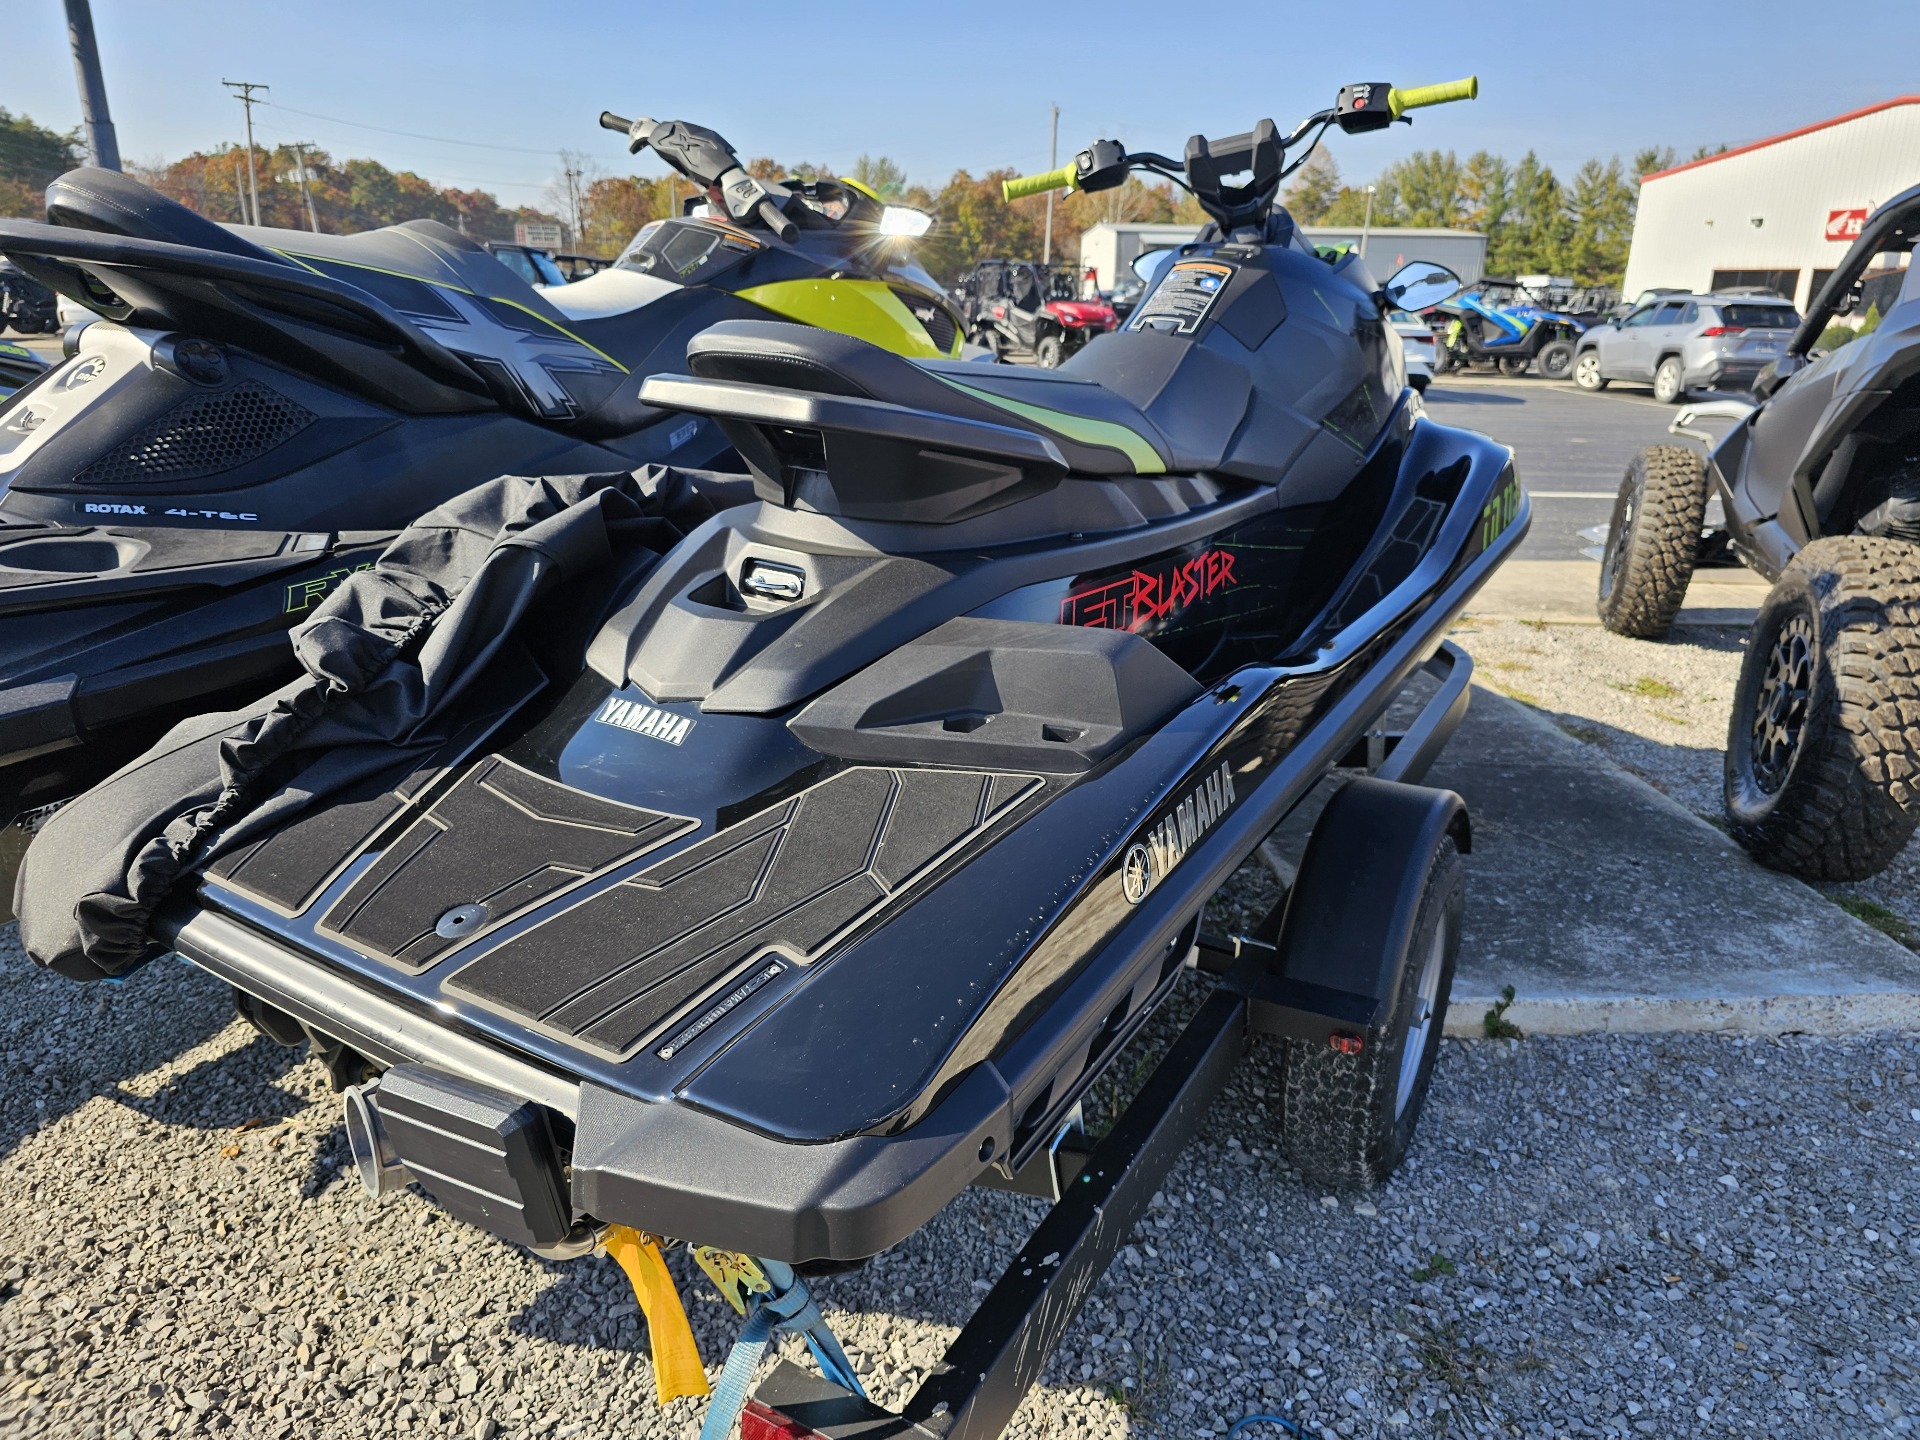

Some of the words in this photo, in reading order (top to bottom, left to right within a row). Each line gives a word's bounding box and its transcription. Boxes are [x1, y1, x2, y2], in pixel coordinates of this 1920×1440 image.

[84, 503, 147, 515] ROTAX
[600, 697, 691, 745] YAMAHA
[1147, 760, 1236, 877] YAMAHA
